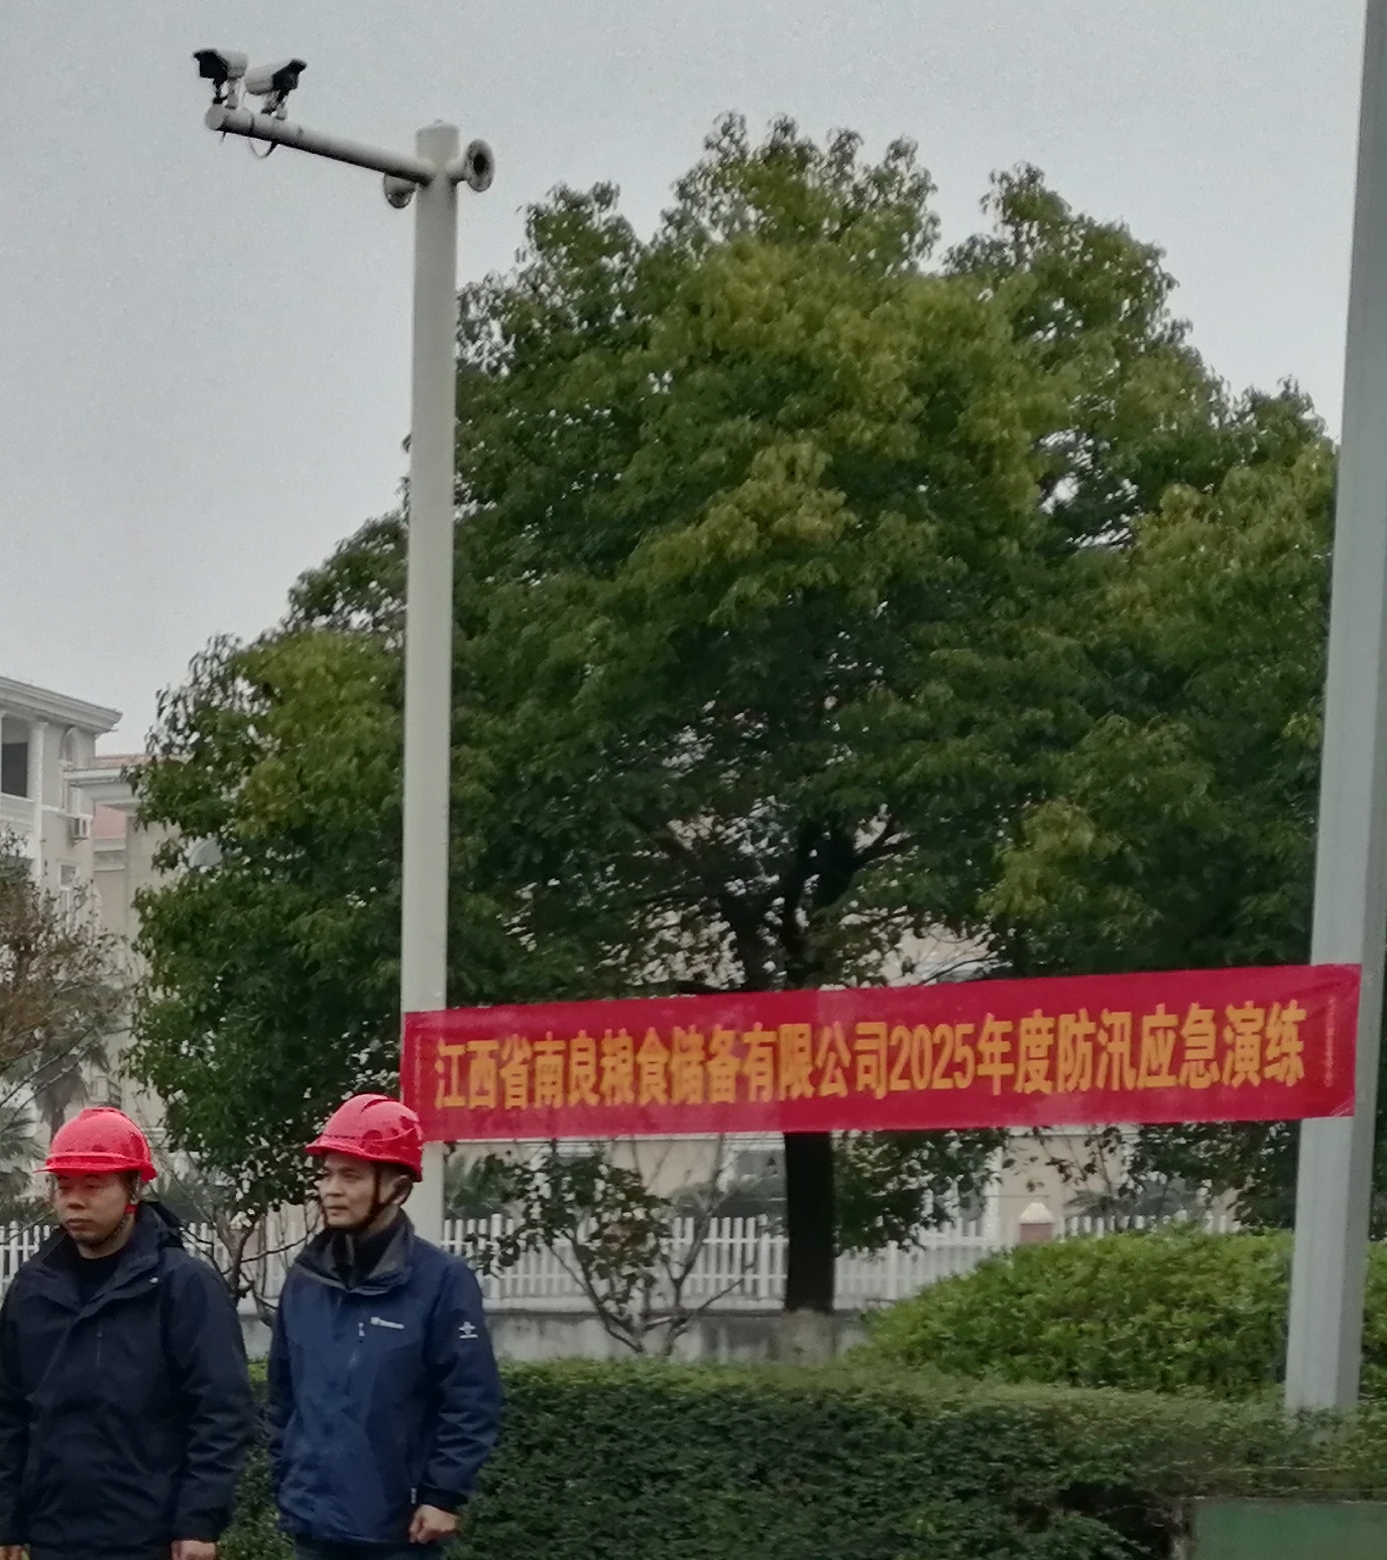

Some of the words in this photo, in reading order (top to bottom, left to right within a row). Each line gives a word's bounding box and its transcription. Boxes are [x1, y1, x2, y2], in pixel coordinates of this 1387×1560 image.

[433, 1000, 1307, 1111] 江西省南良粮食储备有限公司2025年度防汛应急演练
